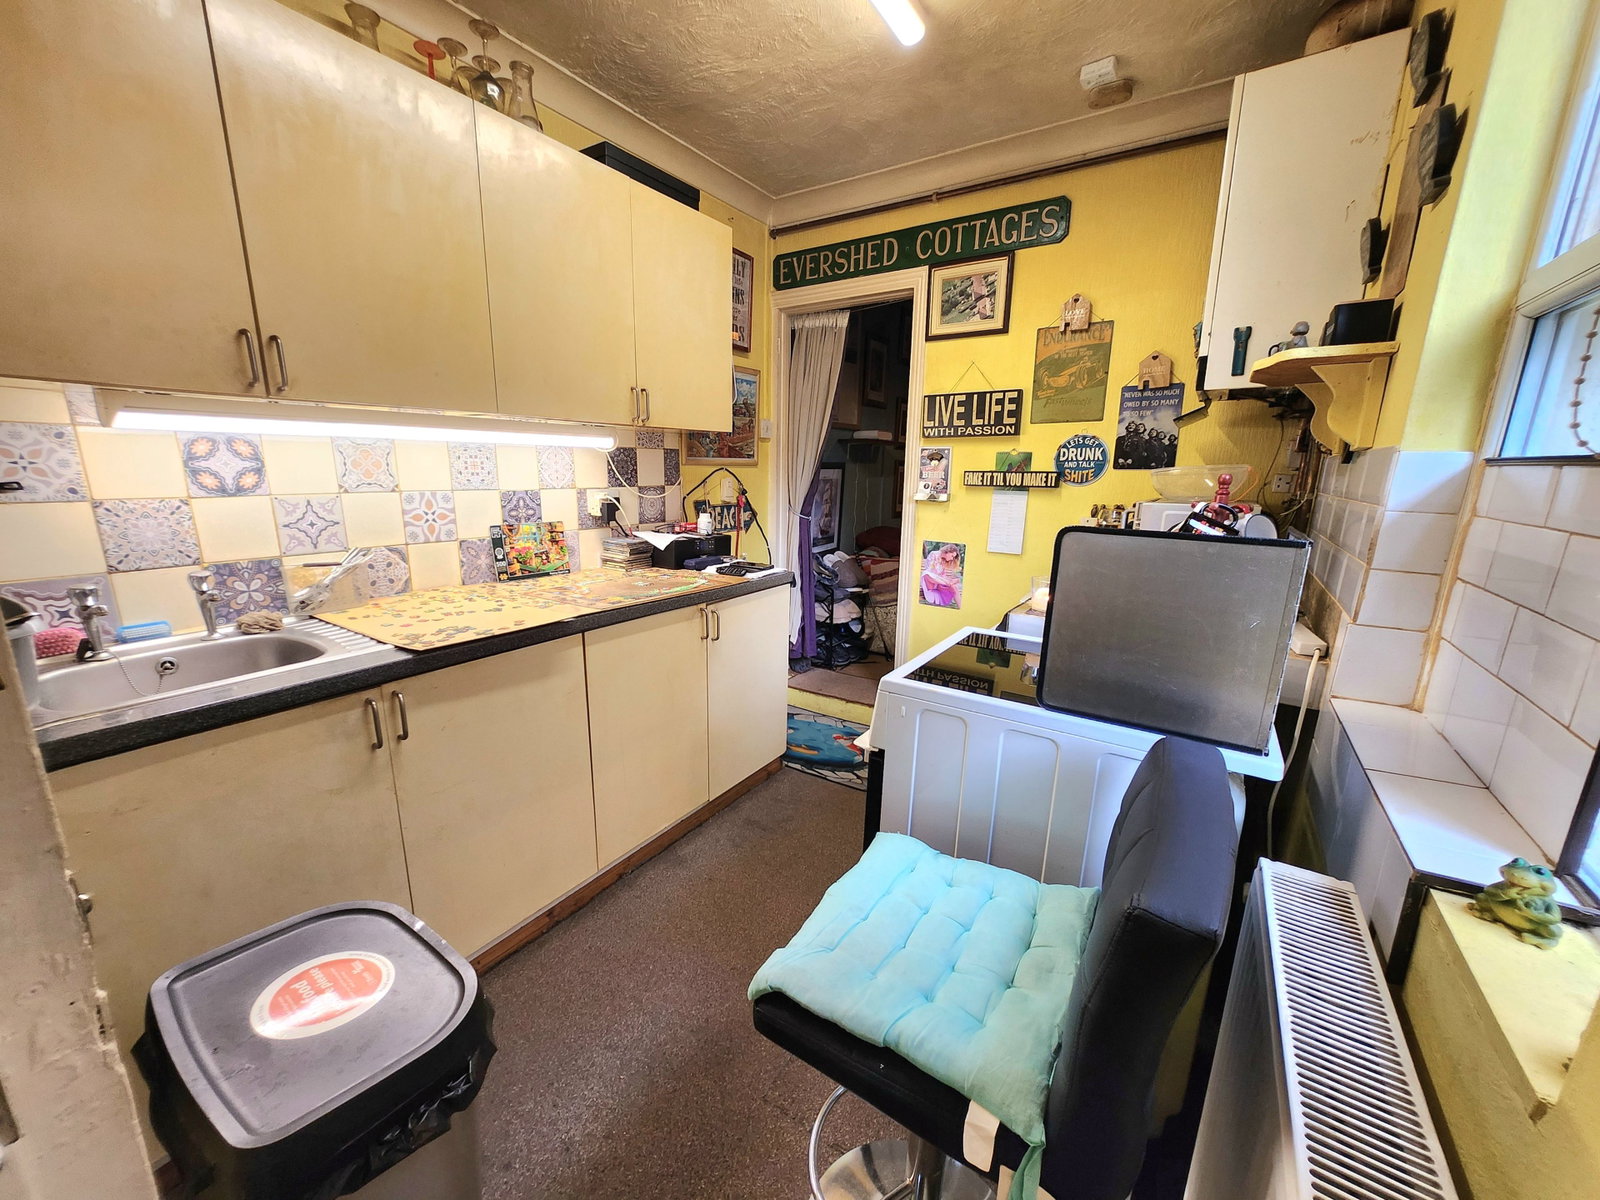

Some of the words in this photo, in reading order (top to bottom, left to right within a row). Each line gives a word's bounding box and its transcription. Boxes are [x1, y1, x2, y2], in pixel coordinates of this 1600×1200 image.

[779, 238, 899, 285] EVERSHED
[916, 205, 1061, 260] COTTAGES
[924, 395, 967, 427] LIVE
[972, 392, 1018, 426] LIFE
[924, 428, 954, 437] WITH
[958, 426, 1015, 436] PASSION
[1066, 437, 1083, 448] LETS
[1085, 438, 1098, 447] GET
[1060, 448, 1104, 461] DRUNK
[964, 472, 983, 485] FAKE
[983, 472, 992, 485] IT
[993, 472, 1004, 486] TIL
[1005, 472, 1022, 486] YOU
[1023, 473, 1047, 486] MAKE
[1047, 473, 1057, 487] IT
[1065, 469, 1095, 482] SHITE
[309, 968, 335, 990] please
